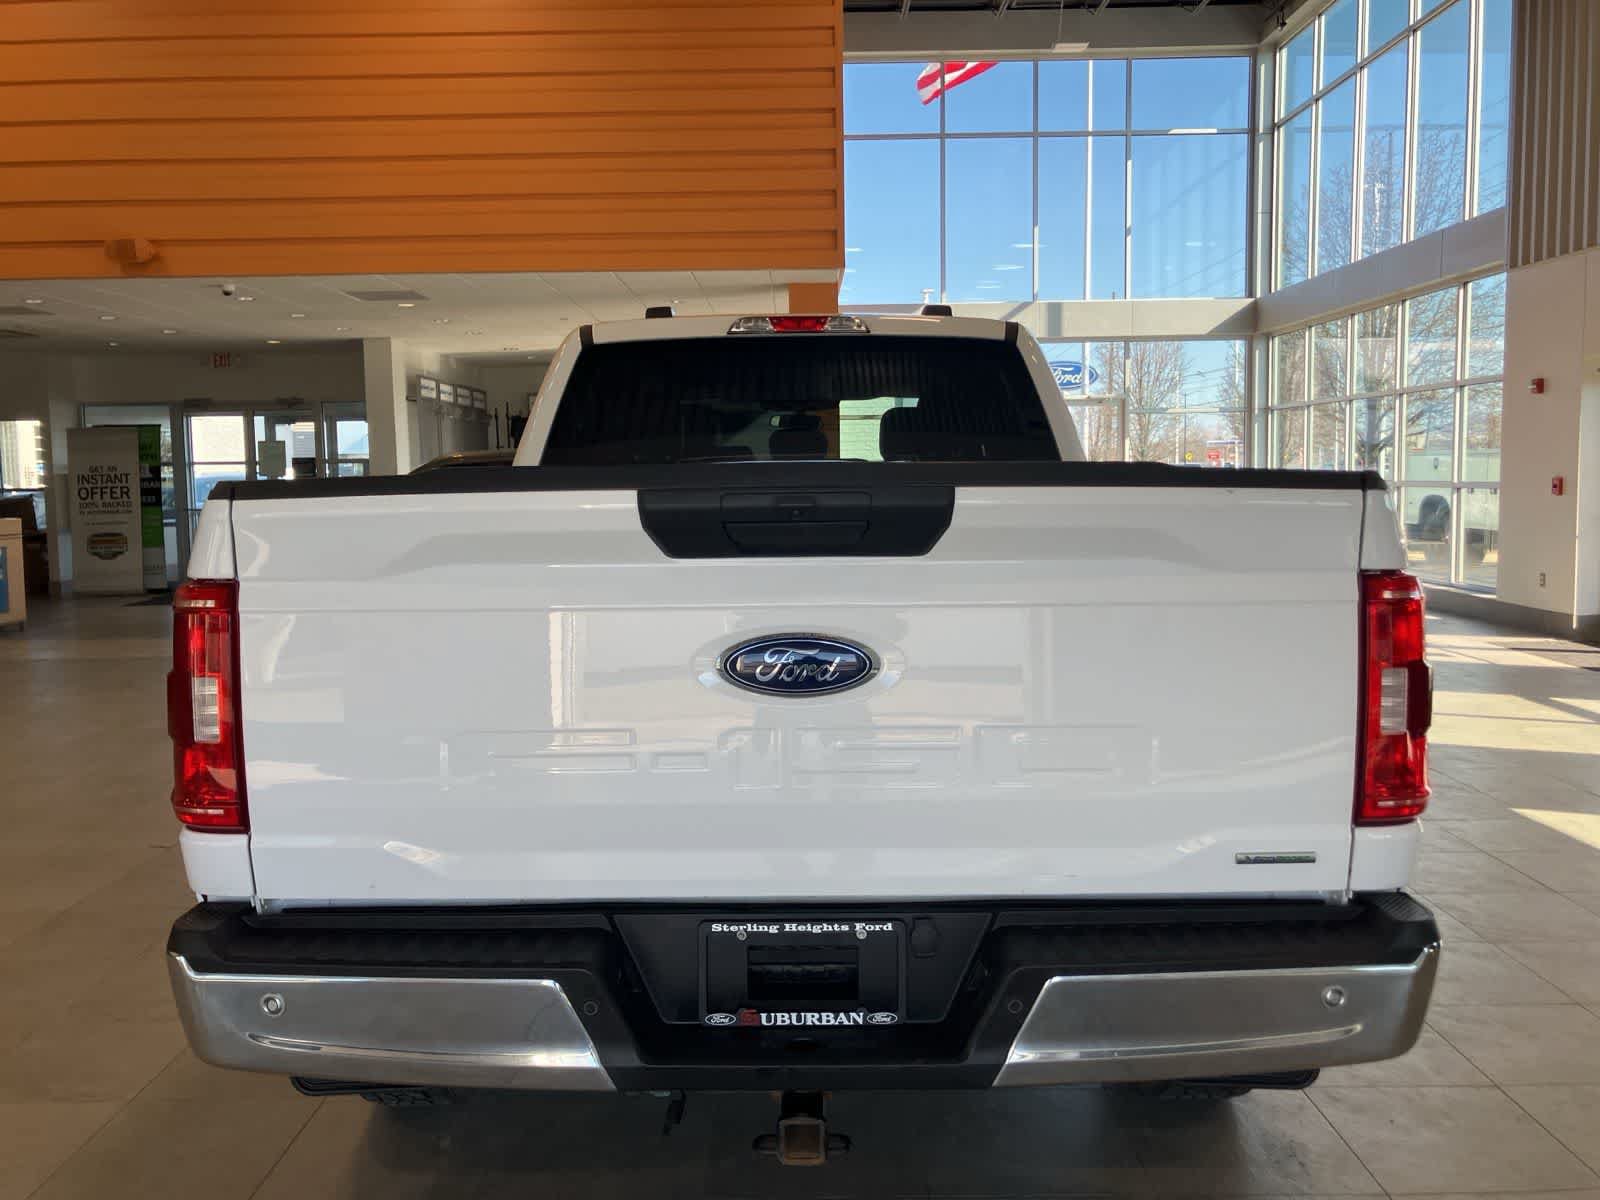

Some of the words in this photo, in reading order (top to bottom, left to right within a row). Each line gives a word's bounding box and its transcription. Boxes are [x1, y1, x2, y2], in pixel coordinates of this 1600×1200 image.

[213, 352, 231, 368] EXIT
[77, 473, 130, 485] INSTANT
[77, 486, 130, 501] OFFER
[755, 647, 840, 682] Ford
[711, 923, 780, 933] Sterling
[783, 923, 850, 933] Heights
[854, 923, 893, 931] Ford
[710, 1015, 731, 1024] Ford
[871, 1014, 893, 1023] Ford
